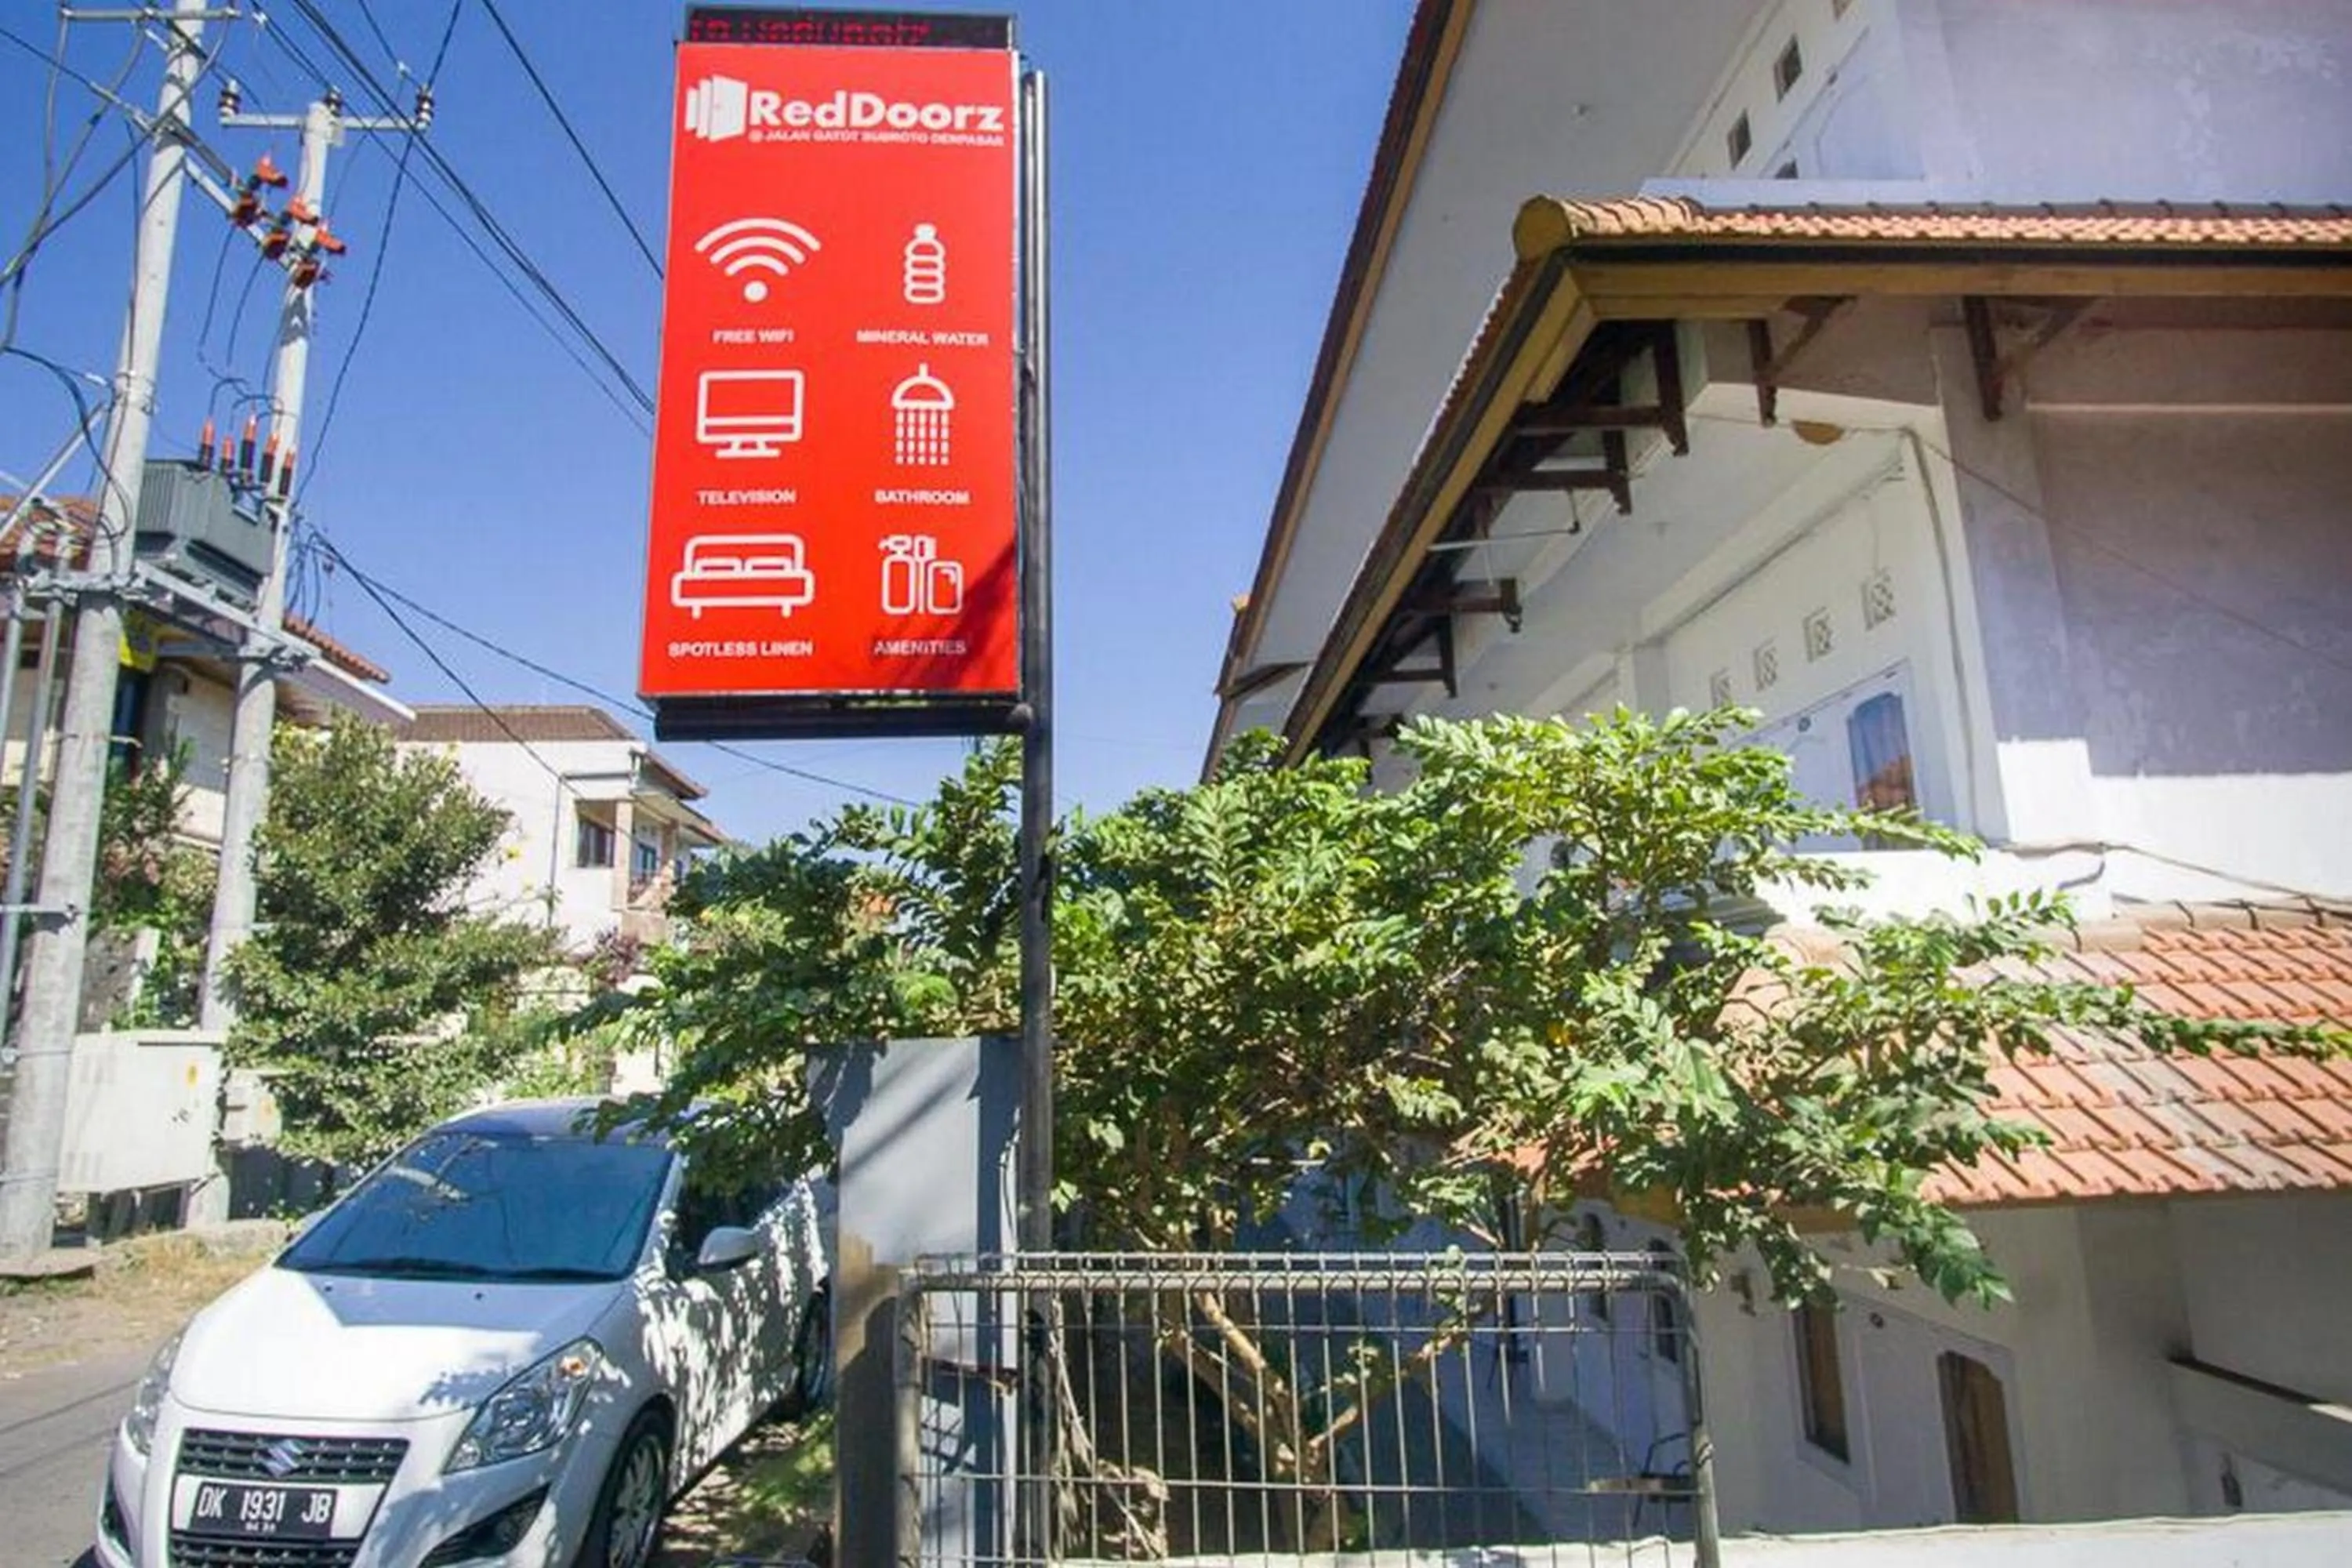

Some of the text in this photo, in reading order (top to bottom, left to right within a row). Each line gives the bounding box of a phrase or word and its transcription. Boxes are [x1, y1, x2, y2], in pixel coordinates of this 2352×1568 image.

[749, 89, 1004, 132] RedDoorz
[765, 130, 811, 143] JALAN
[813, 131, 859, 143] GATOT
[930, 132, 1004, 147] DENPASAR
[713, 328, 794, 343] FREE WIFI
[856, 330, 989, 346] MINERAL WATER
[698, 489, 797, 505] TELEVISION
[874, 489, 970, 506] BATHROOM
[668, 641, 813, 657] SPOTLESS LINEN
[874, 639, 967, 655] AMENITIES
[197, 1486, 332, 1524] DK 1931 JB
